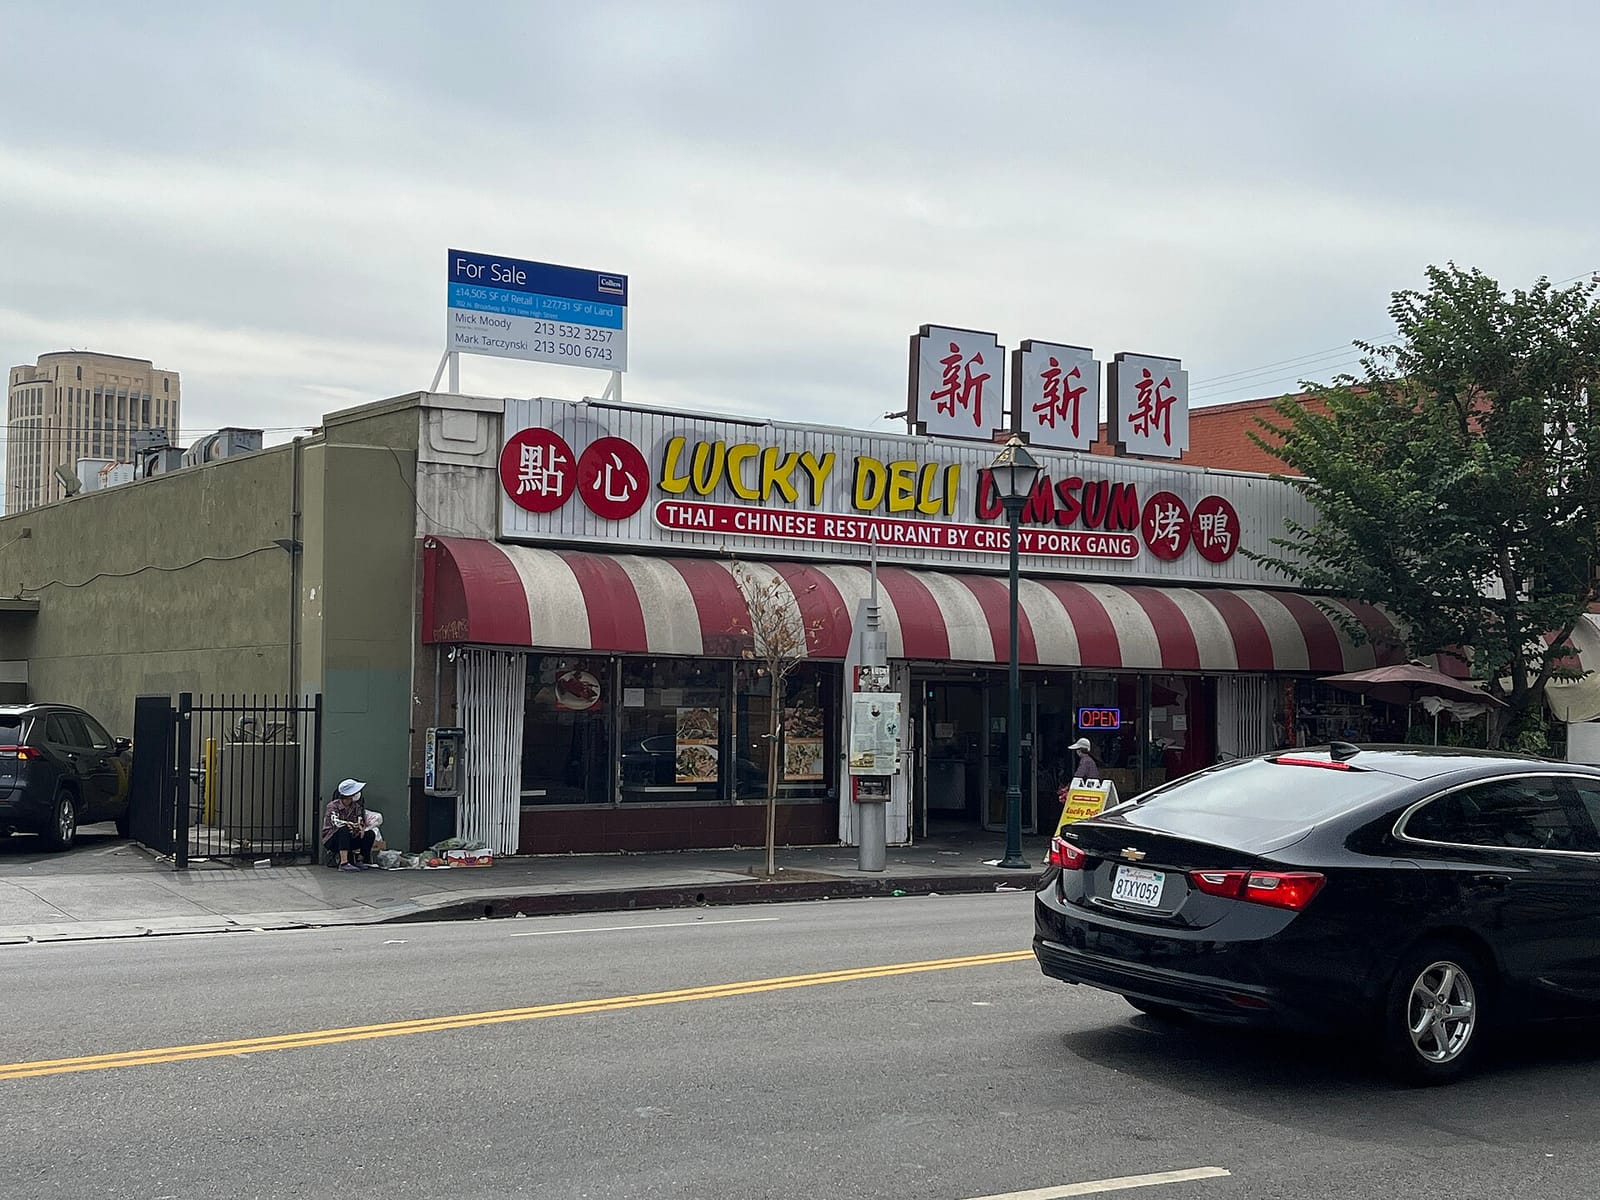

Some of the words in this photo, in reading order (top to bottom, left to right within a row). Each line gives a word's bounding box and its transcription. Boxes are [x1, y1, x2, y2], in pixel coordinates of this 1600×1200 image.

[456, 258, 485, 279] For
[491, 263, 527, 285] Sale
[489, 291, 500, 301] SF
[501, 292, 510, 302] of
[511, 294, 533, 305] Retail
[573, 303, 583, 312] SF
[584, 304, 592, 314] of
[593, 306, 613, 317] Land
[455, 313, 477, 324] Mick
[480, 316, 512, 331] Moody
[534, 321, 555, 336] 213
[559, 325, 580, 339] 532
[584, 328, 613, 343] 3257
[455, 333, 479, 345] Mark
[481, 336, 528, 351] Tarczynski
[534, 340, 555, 354] 213
[559, 343, 581, 357] 500
[584, 346, 613, 361] 6743
[930, 342, 991, 428] 新
[1032, 356, 1088, 439] 新
[1128, 368, 1177, 447] 新
[657, 436, 836, 506] LUCKY
[851, 455, 961, 516] DELI
[975, 467, 1140, 530] DMSUM
[666, 505, 714, 527] THAI
[734, 511, 817, 535] CHINESE
[823, 519, 941, 545] RESTAURANT
[947, 528, 968, 546] BY
[1038, 534, 1081, 552] PORK
[1086, 536, 1131, 555] GANG
[1081, 710, 1119, 727] OPEN
[1115, 878, 1160, 901] 8TXY059
